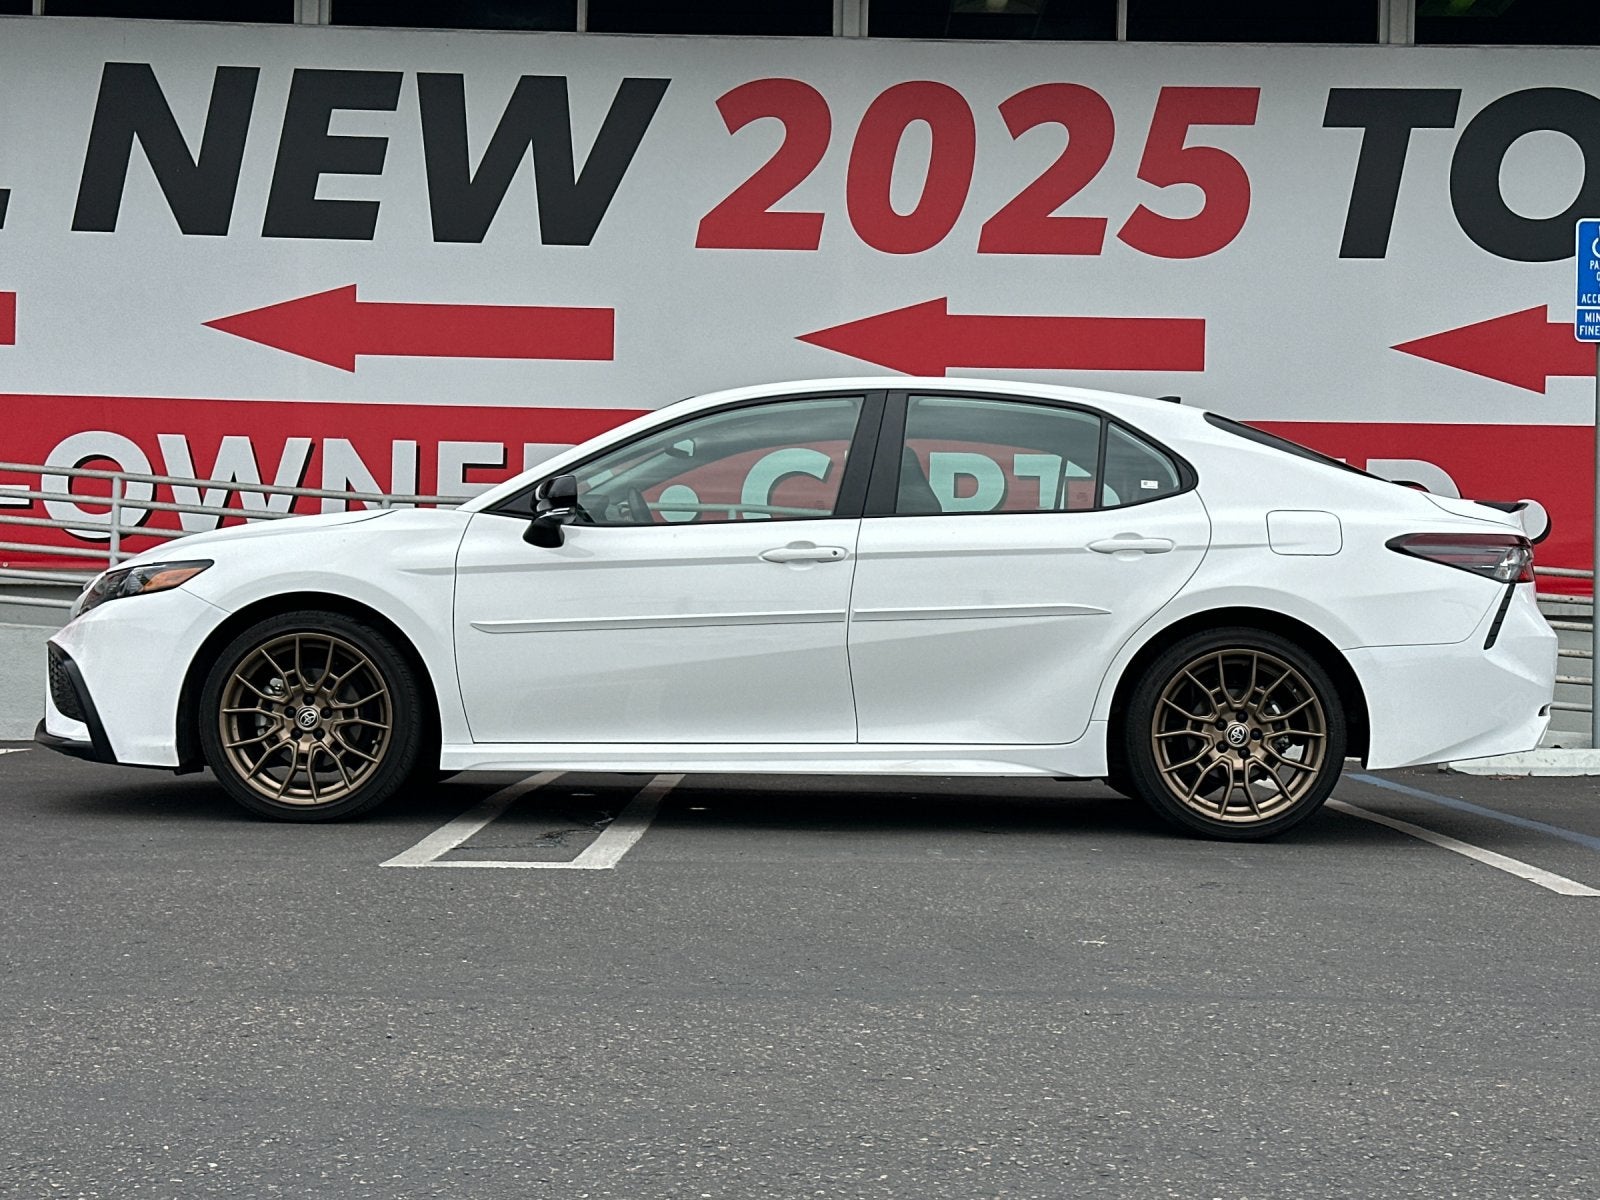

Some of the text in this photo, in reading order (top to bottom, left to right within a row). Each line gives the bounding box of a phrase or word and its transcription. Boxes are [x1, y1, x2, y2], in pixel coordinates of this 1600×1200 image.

[71, 61, 1600, 262] NEW 2025 TO
